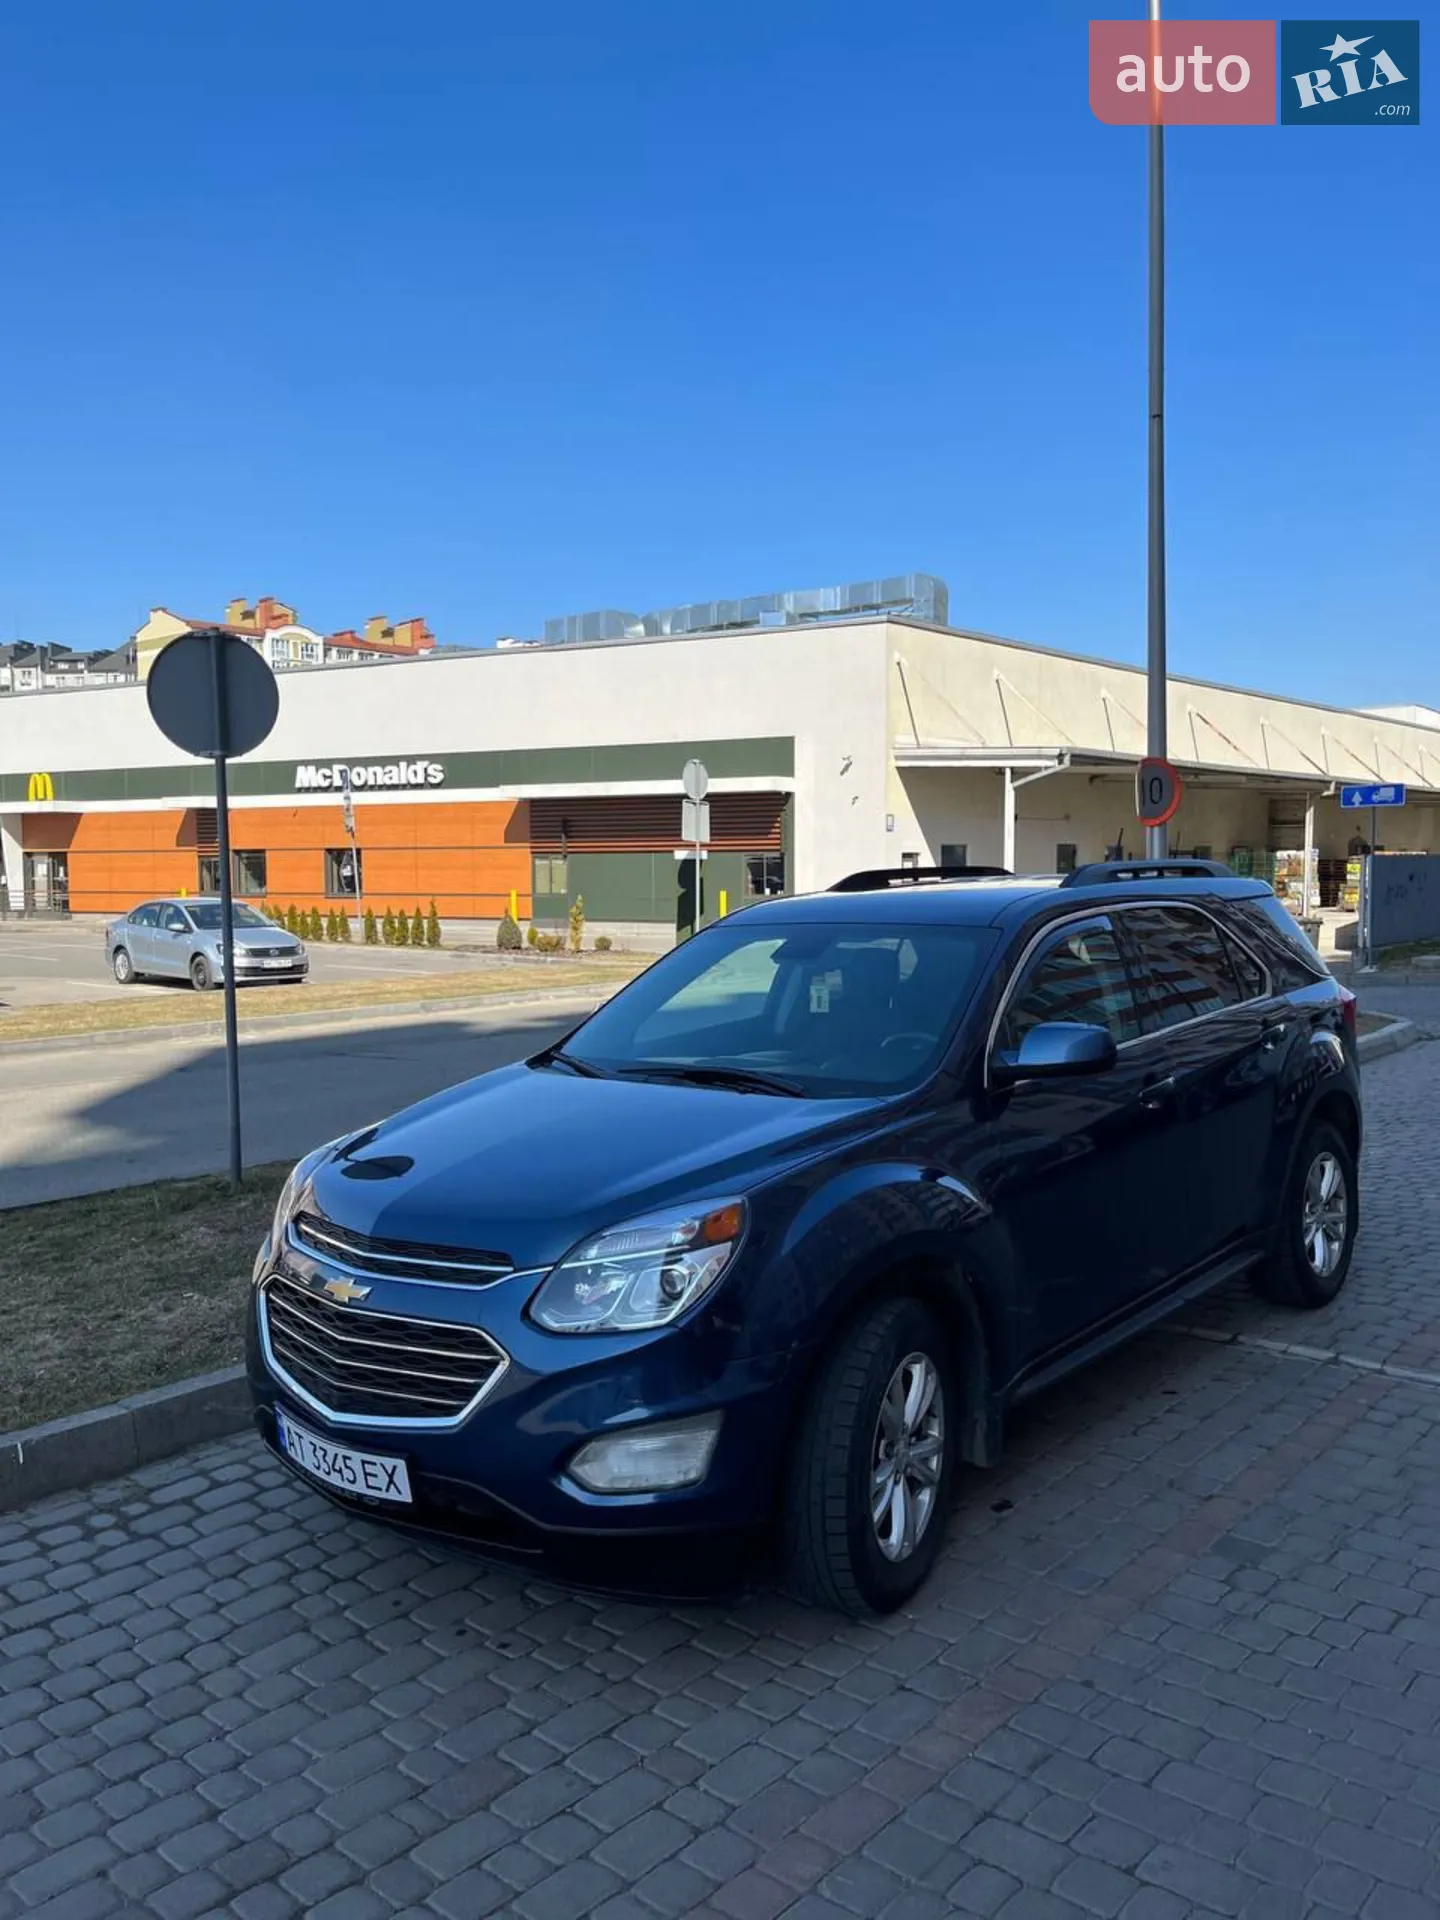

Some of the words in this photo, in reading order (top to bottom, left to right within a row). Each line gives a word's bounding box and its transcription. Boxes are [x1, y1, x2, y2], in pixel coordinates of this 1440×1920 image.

[295, 761, 445, 789] McDonald's
[309, 1440, 358, 1486] 3345
[360, 1458, 404, 1496] EX
